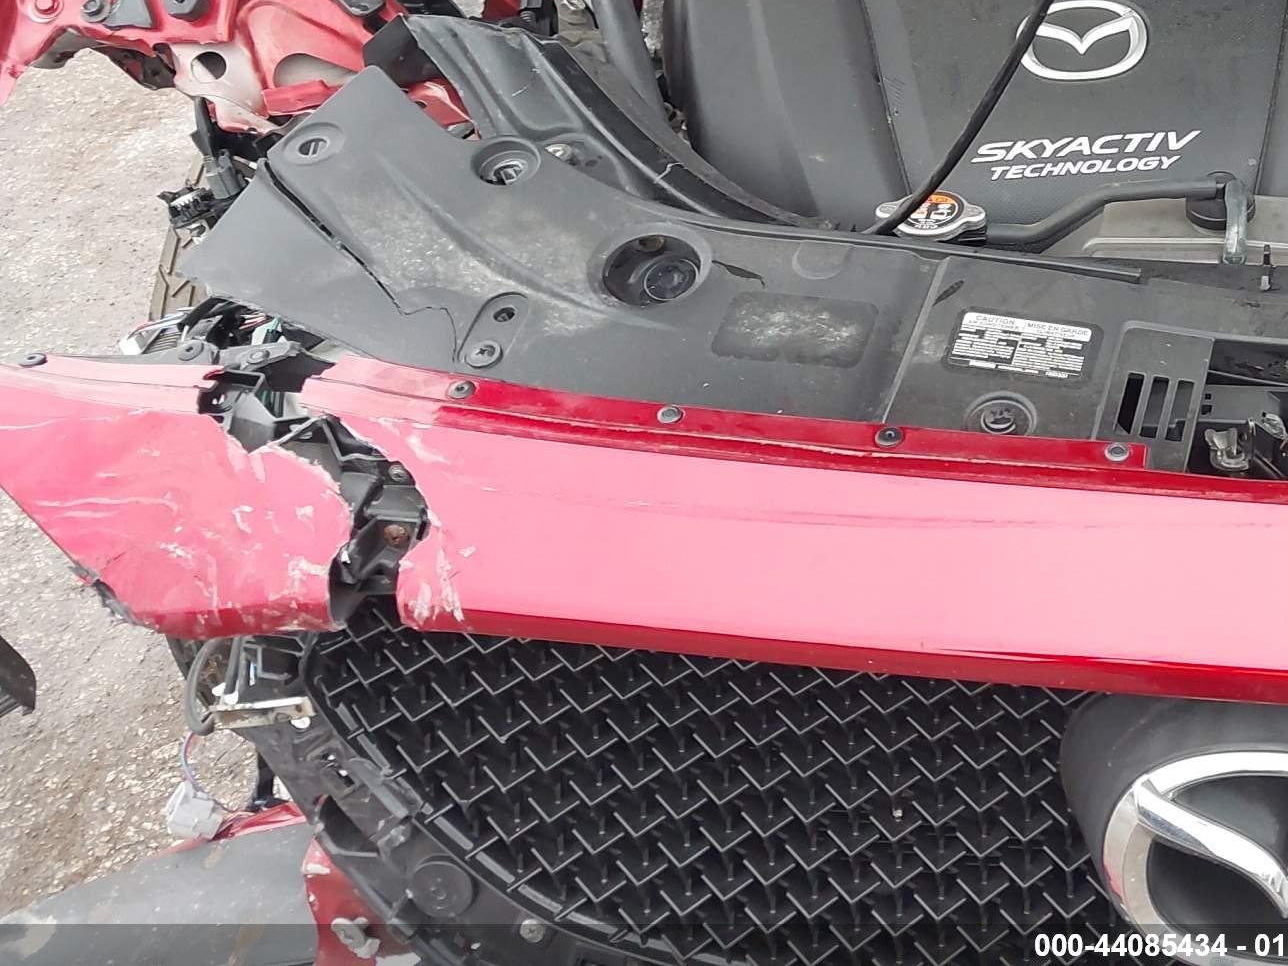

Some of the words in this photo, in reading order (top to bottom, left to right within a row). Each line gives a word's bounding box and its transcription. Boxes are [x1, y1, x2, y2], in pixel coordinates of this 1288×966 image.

[971, 130, 1201, 162] SKYACTIV
[990, 155, 1181, 180] TECHNOLOGY
[975, 315, 1016, 325] CAUTION
